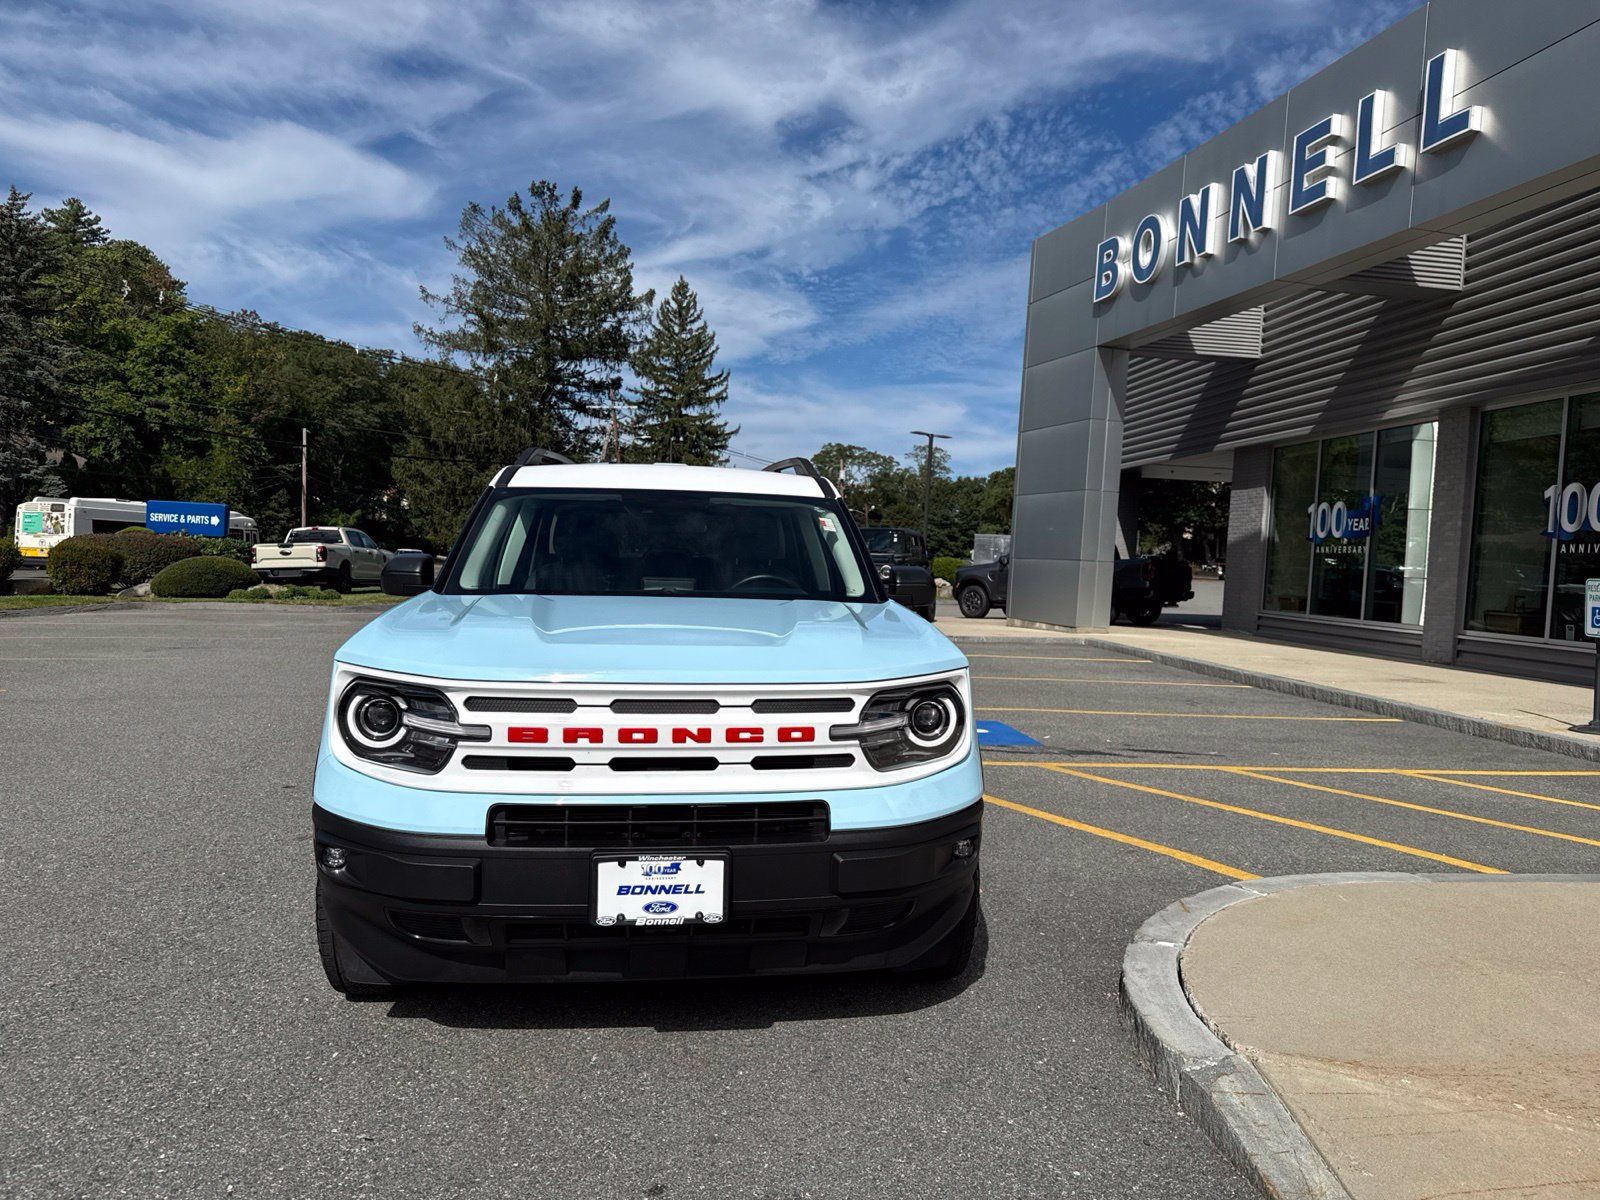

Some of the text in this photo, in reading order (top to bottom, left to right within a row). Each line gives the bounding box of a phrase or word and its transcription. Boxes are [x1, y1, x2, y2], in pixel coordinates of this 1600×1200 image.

[1093, 48, 1484, 303] BONNELL
[150, 513, 209, 525] SERVICE & PARTS
[1307, 501, 1347, 538] 100
[1316, 545, 1368, 554] ANNIVERSARY
[507, 726, 815, 744] BRONCO
[641, 863, 663, 876] 100
[616, 884, 705, 895] BONNELL
[648, 902, 672, 913] Ford
[635, 916, 685, 926] Bonnell
